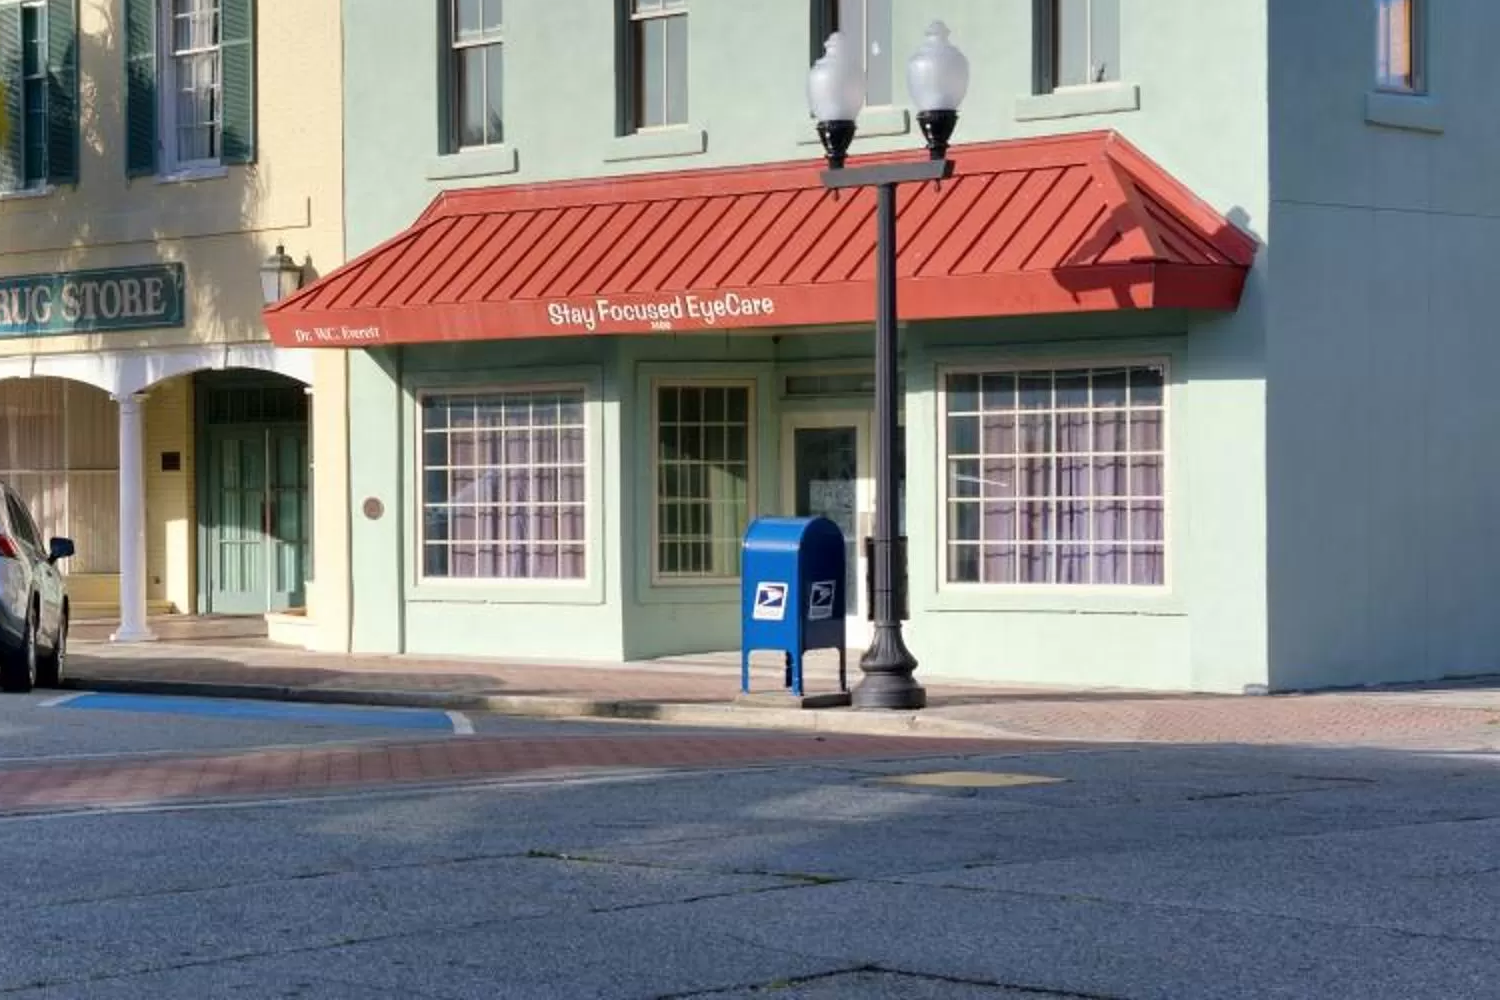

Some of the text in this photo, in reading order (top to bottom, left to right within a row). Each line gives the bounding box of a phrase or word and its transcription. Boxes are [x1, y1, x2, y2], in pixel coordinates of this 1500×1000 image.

[61, 276, 167, 322] STORE
[547, 292, 775, 331] Stay Focused EyeCare
